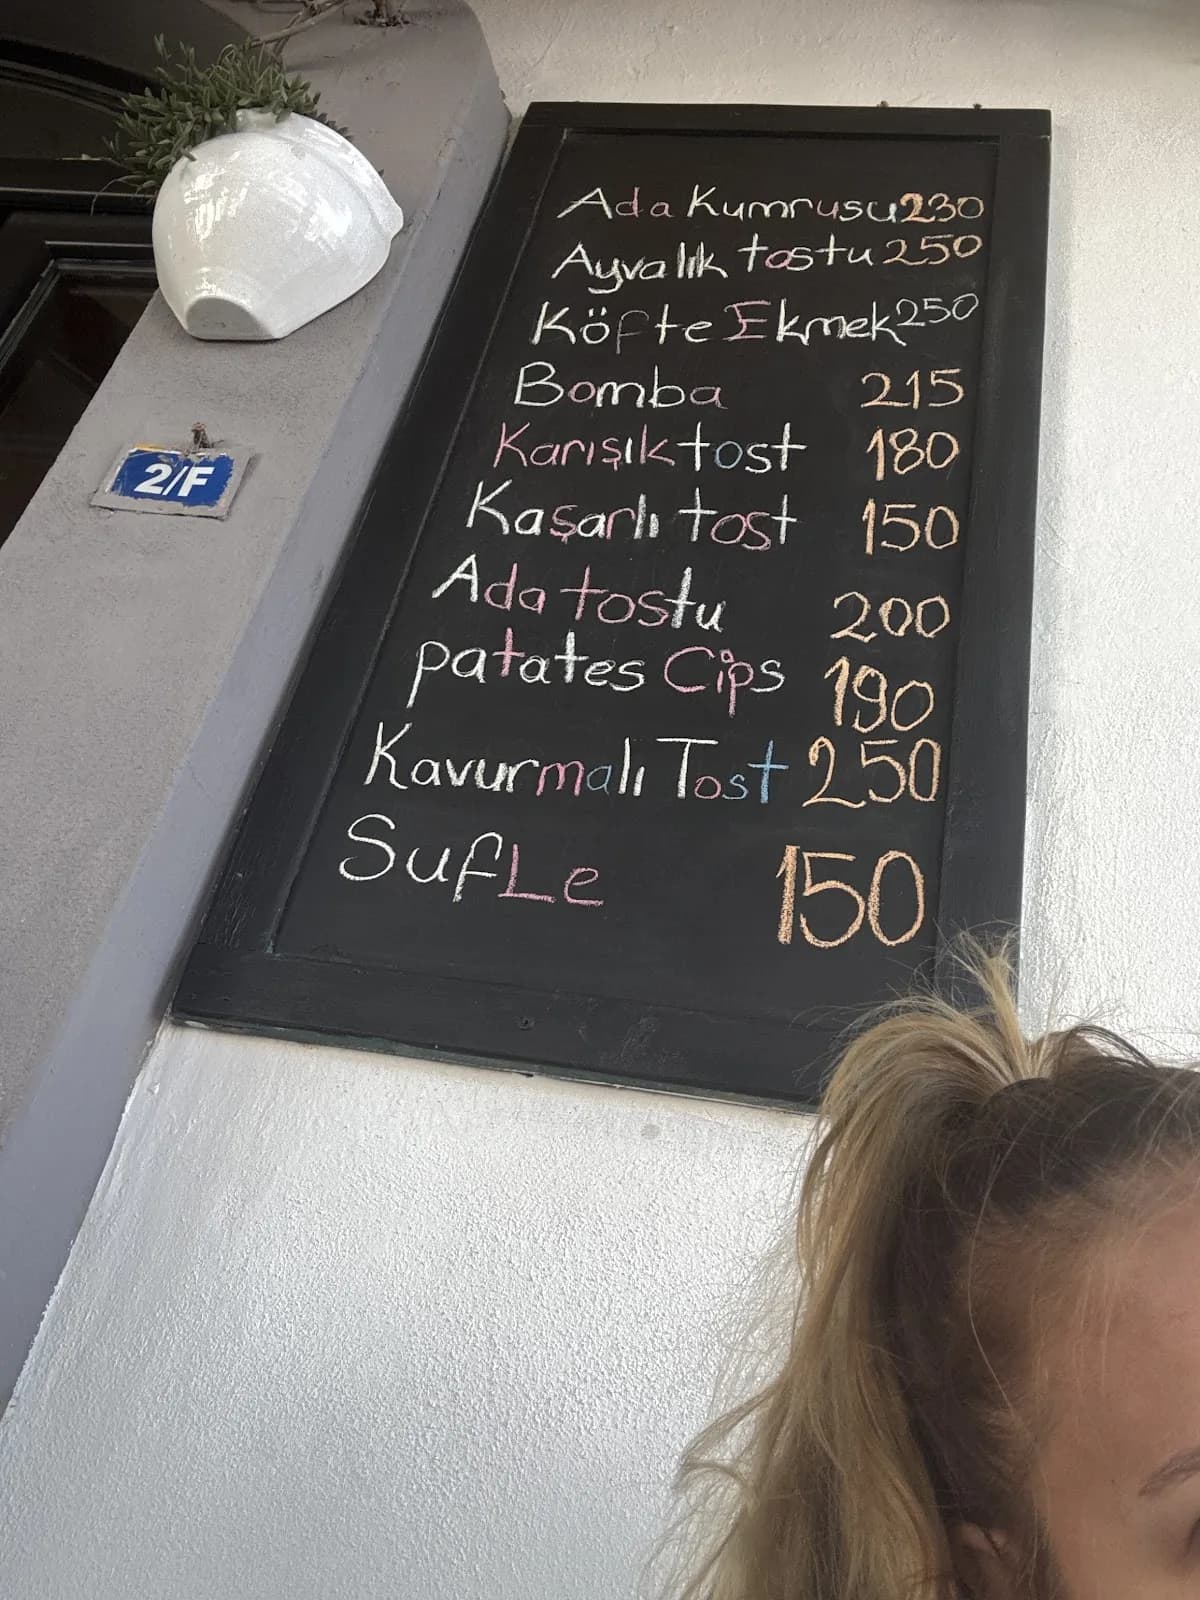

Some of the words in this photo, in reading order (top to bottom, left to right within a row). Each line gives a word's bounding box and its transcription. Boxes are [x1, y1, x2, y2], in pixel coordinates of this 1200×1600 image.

[556, 186, 674, 219] Ada
[686, 183, 898, 222] Kumrusu
[899, 192, 985, 224] 230
[551, 241, 729, 295] Ayvalık
[737, 232, 874, 273] tostu
[882, 233, 983, 266] 250
[531, 300, 713, 355] Köfte
[722, 297, 908, 347] Ekmek
[895, 292, 980, 328] 250
[513, 360, 729, 410] Bomba
[860, 367, 965, 410] 215
[133, 463, 215, 497] 2/F
[492, 421, 676, 472] Karışık
[676, 421, 808, 475] tost
[865, 427, 961, 482] 180
[465, 478, 660, 541] Kaşarlı
[677, 486, 798, 552] tost
[861, 498, 961, 556] 150
[431, 553, 546, 618] Ada
[559, 565, 726, 634] tostu
[829, 591, 952, 645] 200
[663, 645, 786, 719] Cips
[823, 655, 936, 734] 190
[363, 721, 646, 798] Kavurmalı
[655, 737, 790, 804] Tost
[801, 735, 942, 809] 250
[775, 844, 926, 950] 150
